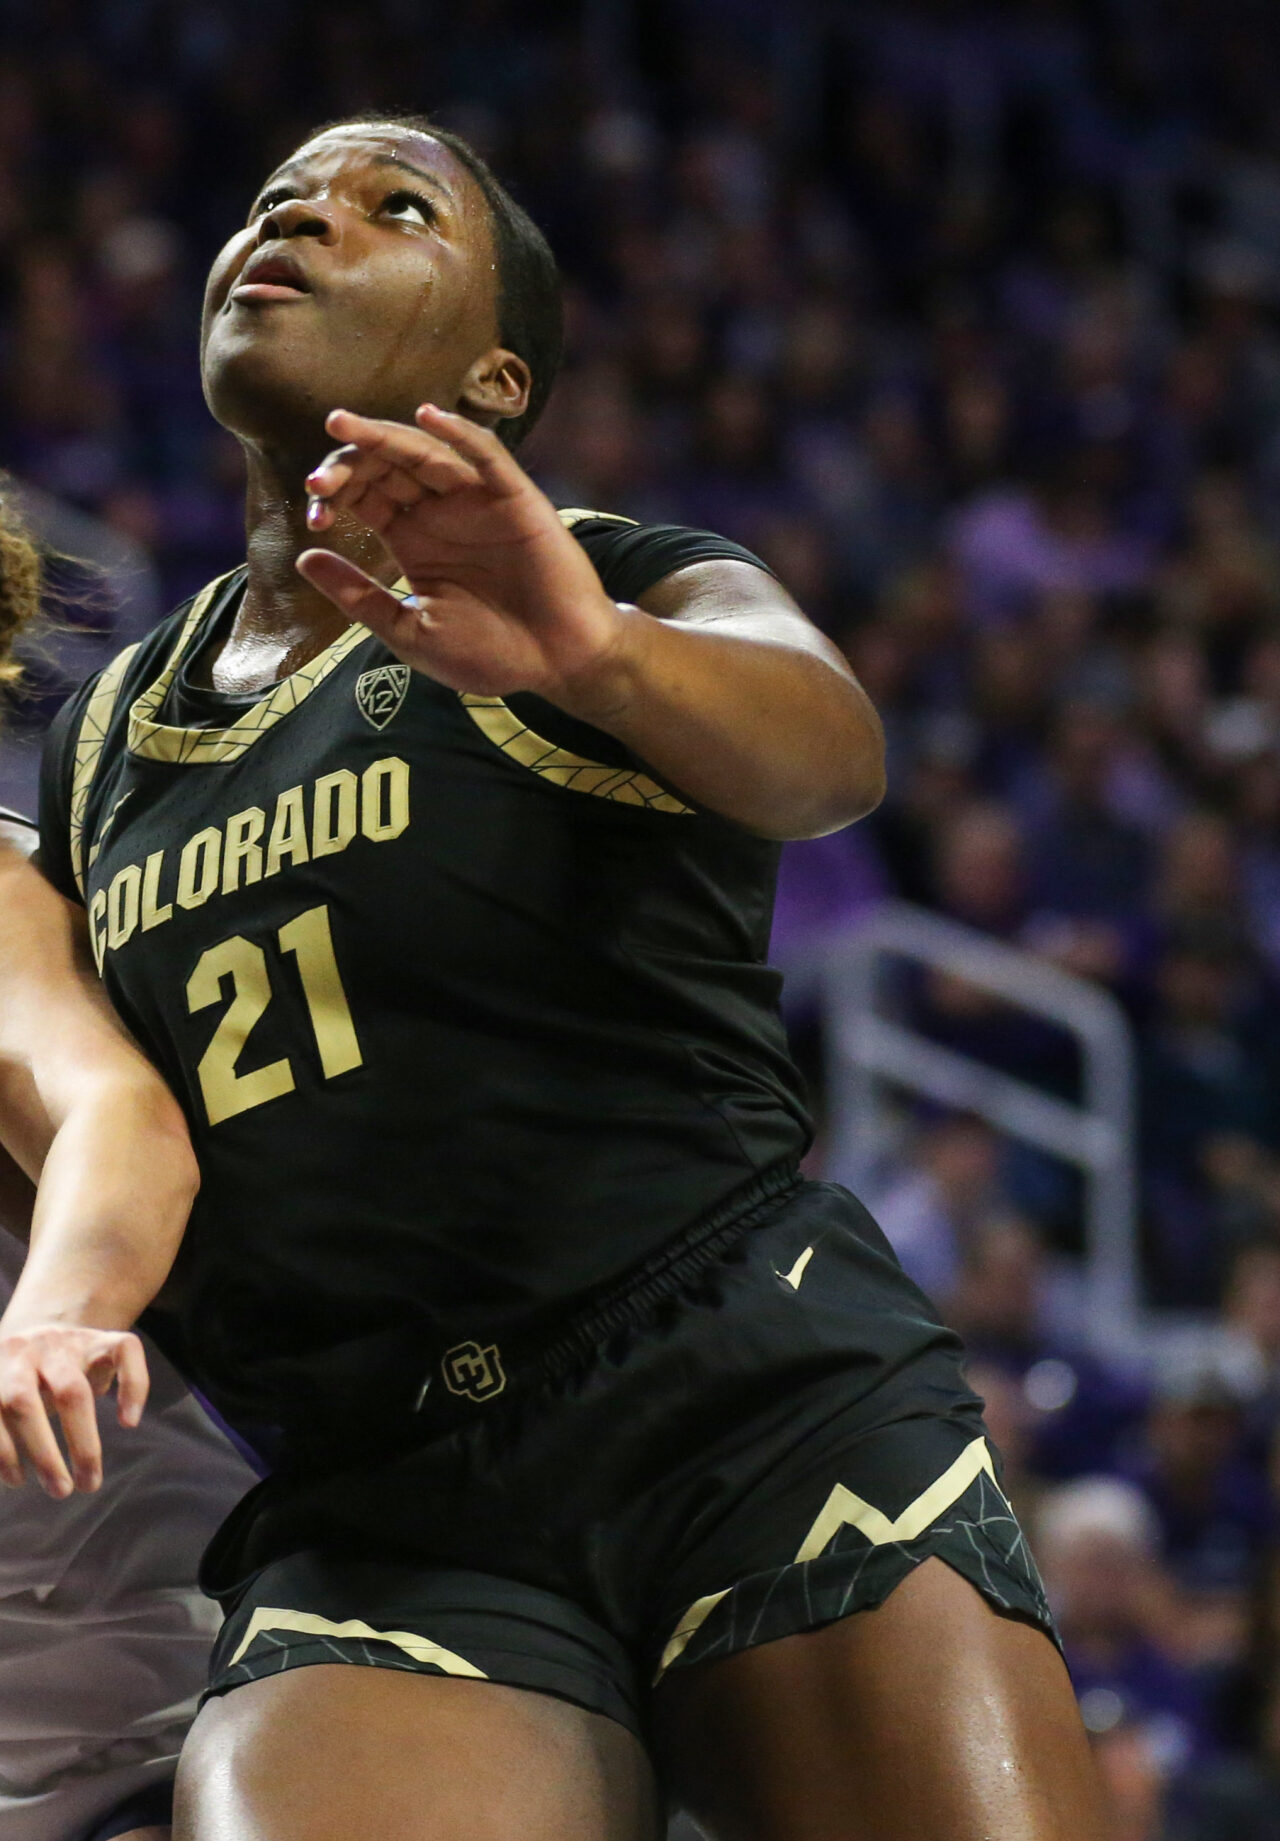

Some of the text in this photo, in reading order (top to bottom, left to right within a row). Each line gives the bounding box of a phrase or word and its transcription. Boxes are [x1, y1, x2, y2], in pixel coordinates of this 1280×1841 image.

[360, 668, 408, 705] PAC
[368, 691, 394, 715] 12
[87, 757, 410, 978] COLORADO
[186, 904, 364, 1126] 21
